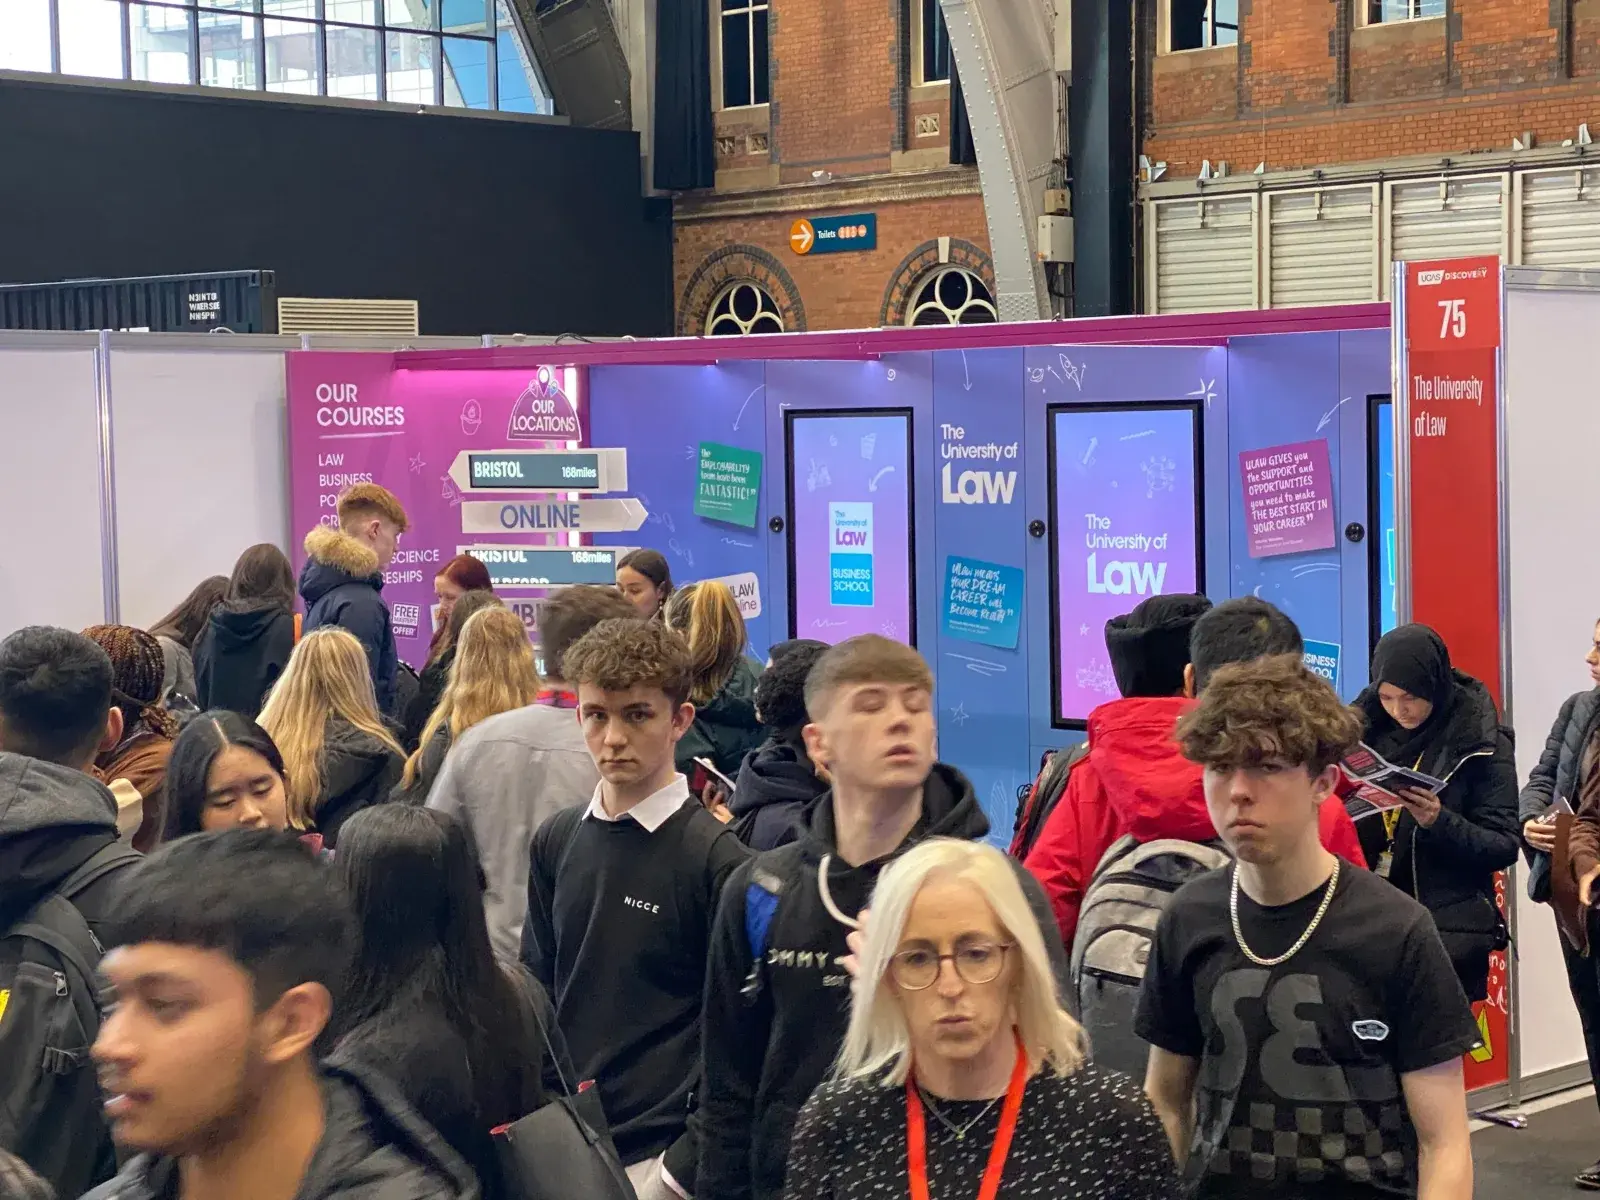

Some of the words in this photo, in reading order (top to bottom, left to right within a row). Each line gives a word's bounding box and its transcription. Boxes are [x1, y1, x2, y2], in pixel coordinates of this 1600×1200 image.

[817, 229, 836, 239] Toilets
[1420, 273, 1441, 282] UCAS
[1444, 269, 1487, 280] DISCOVERY
[1438, 299, 1466, 339] 75
[316, 383, 358, 403] OUR
[1413, 375, 1433, 400] The
[1433, 374, 1483, 407] University
[316, 406, 405, 426] COURSES
[532, 399, 555, 414] OUR
[512, 415, 576, 432] LOCATIONS
[940, 423, 965, 440] The
[1414, 410, 1426, 437] of
[1426, 411, 1447, 437] Law
[318, 453, 344, 467] LAW
[941, 442, 1002, 462] University
[1004, 442, 1018, 459] of
[1245, 458, 1267, 471] ULAW
[1268, 452, 1293, 466] GIVES
[1294, 452, 1309, 465] you
[473, 461, 524, 479] BRISTOL
[561, 466, 597, 479] 168miles
[1247, 472, 1260, 484] the
[1260, 465, 1298, 481] SUPPORT
[1298, 461, 1314, 474] and
[319, 473, 373, 487] BUSINESS
[941, 461, 1018, 505] Law
[1248, 475, 1314, 496] OPPORTUNITIES
[1250, 499, 1265, 511] you
[1265, 493, 1284, 506] need
[1284, 491, 1294, 502] to
[1295, 488, 1316, 500] make
[500, 504, 581, 529] ONLINE
[1251, 508, 1268, 521] THE
[1269, 504, 1289, 519] BEST
[1289, 500, 1318, 514] START
[1317, 498, 1329, 510] IN
[1084, 512, 1112, 530] The
[1253, 521, 1276, 535] YOUR
[835, 527, 867, 546] Law
[1085, 532, 1152, 553] University
[1152, 532, 1168, 550] of
[571, 551, 612, 563] 168miles
[832, 568, 871, 580] BUSINESS
[1086, 551, 1167, 596] Law
[833, 580, 871, 593] SCHOOL
[970, 578, 1007, 596] DREAM
[949, 588, 989, 607] CAREER
[394, 605, 418, 618] FREE
[623, 895, 660, 914] NICCE
